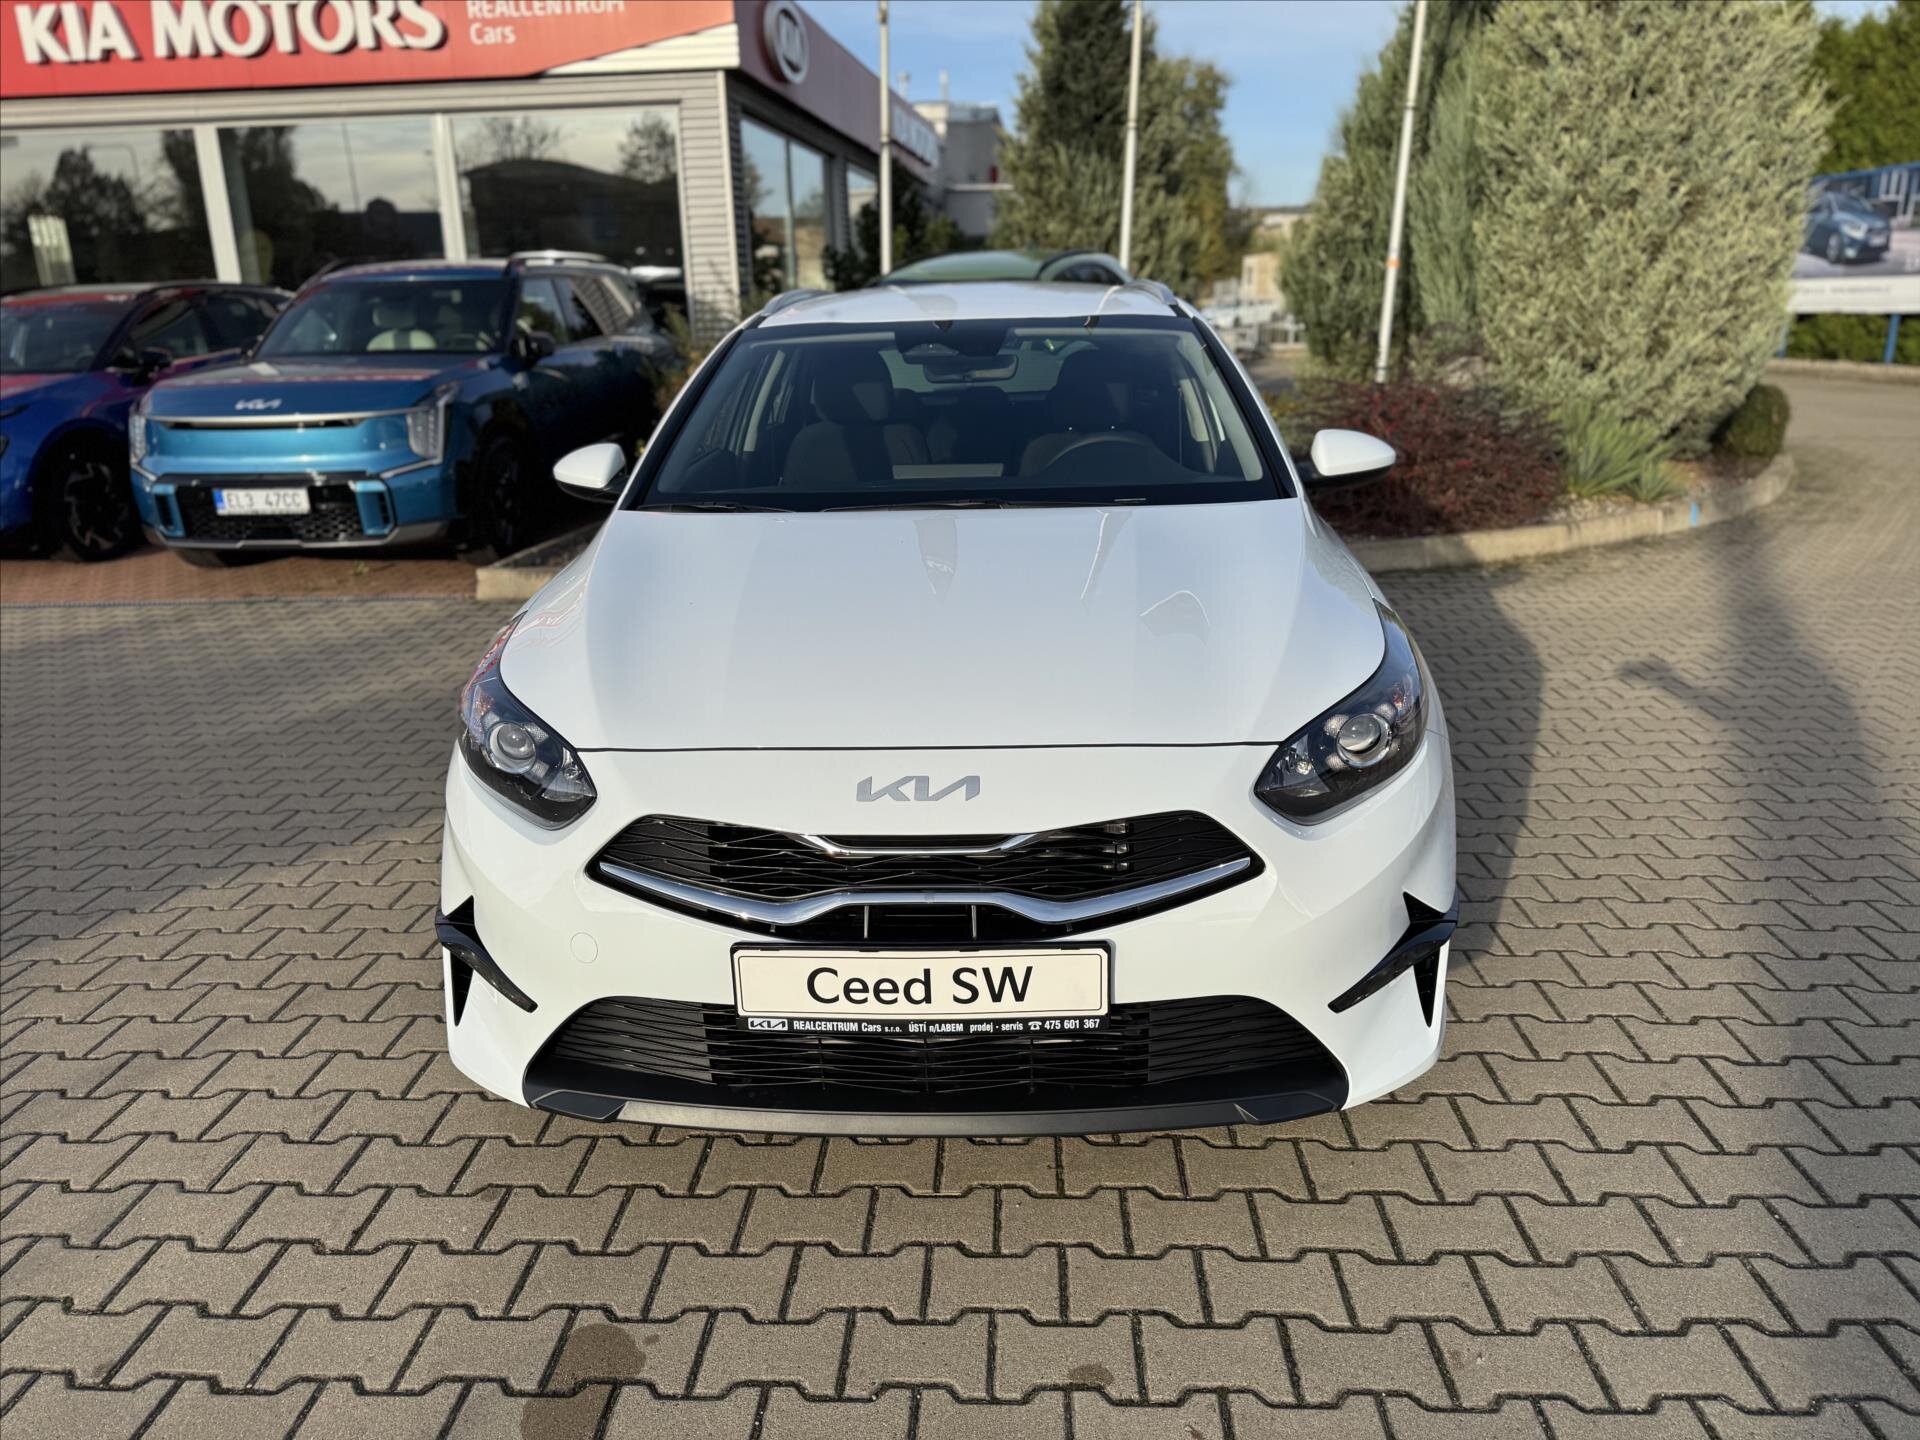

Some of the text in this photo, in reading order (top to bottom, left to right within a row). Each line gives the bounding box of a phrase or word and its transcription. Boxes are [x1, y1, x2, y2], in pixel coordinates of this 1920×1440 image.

[467, 0, 625, 19] REALCENTRUM
[14, 0, 445, 64] KIA MOTORS
[469, 22, 517, 45] Cars
[855, 775, 981, 801] KIA
[806, 965, 1033, 1005] Ceed SW
[749, 1019, 787, 1030] KIA
[793, 1020, 859, 1032] REALCENTRUM
[861, 1022, 882, 1032] Cars
[884, 1025, 902, 1033] s.r.o.
[908, 1021, 927, 1032] ÚSTÍ
[929, 1023, 964, 1033] n/LABEM
[970, 1022, 994, 1033] prodej
[1001, 1021, 1024, 1031] servis
[1044, 1020, 1061, 1030] 475
[1064, 1019, 1080, 1029] 601
[1083, 1018, 1100, 1028] 367
